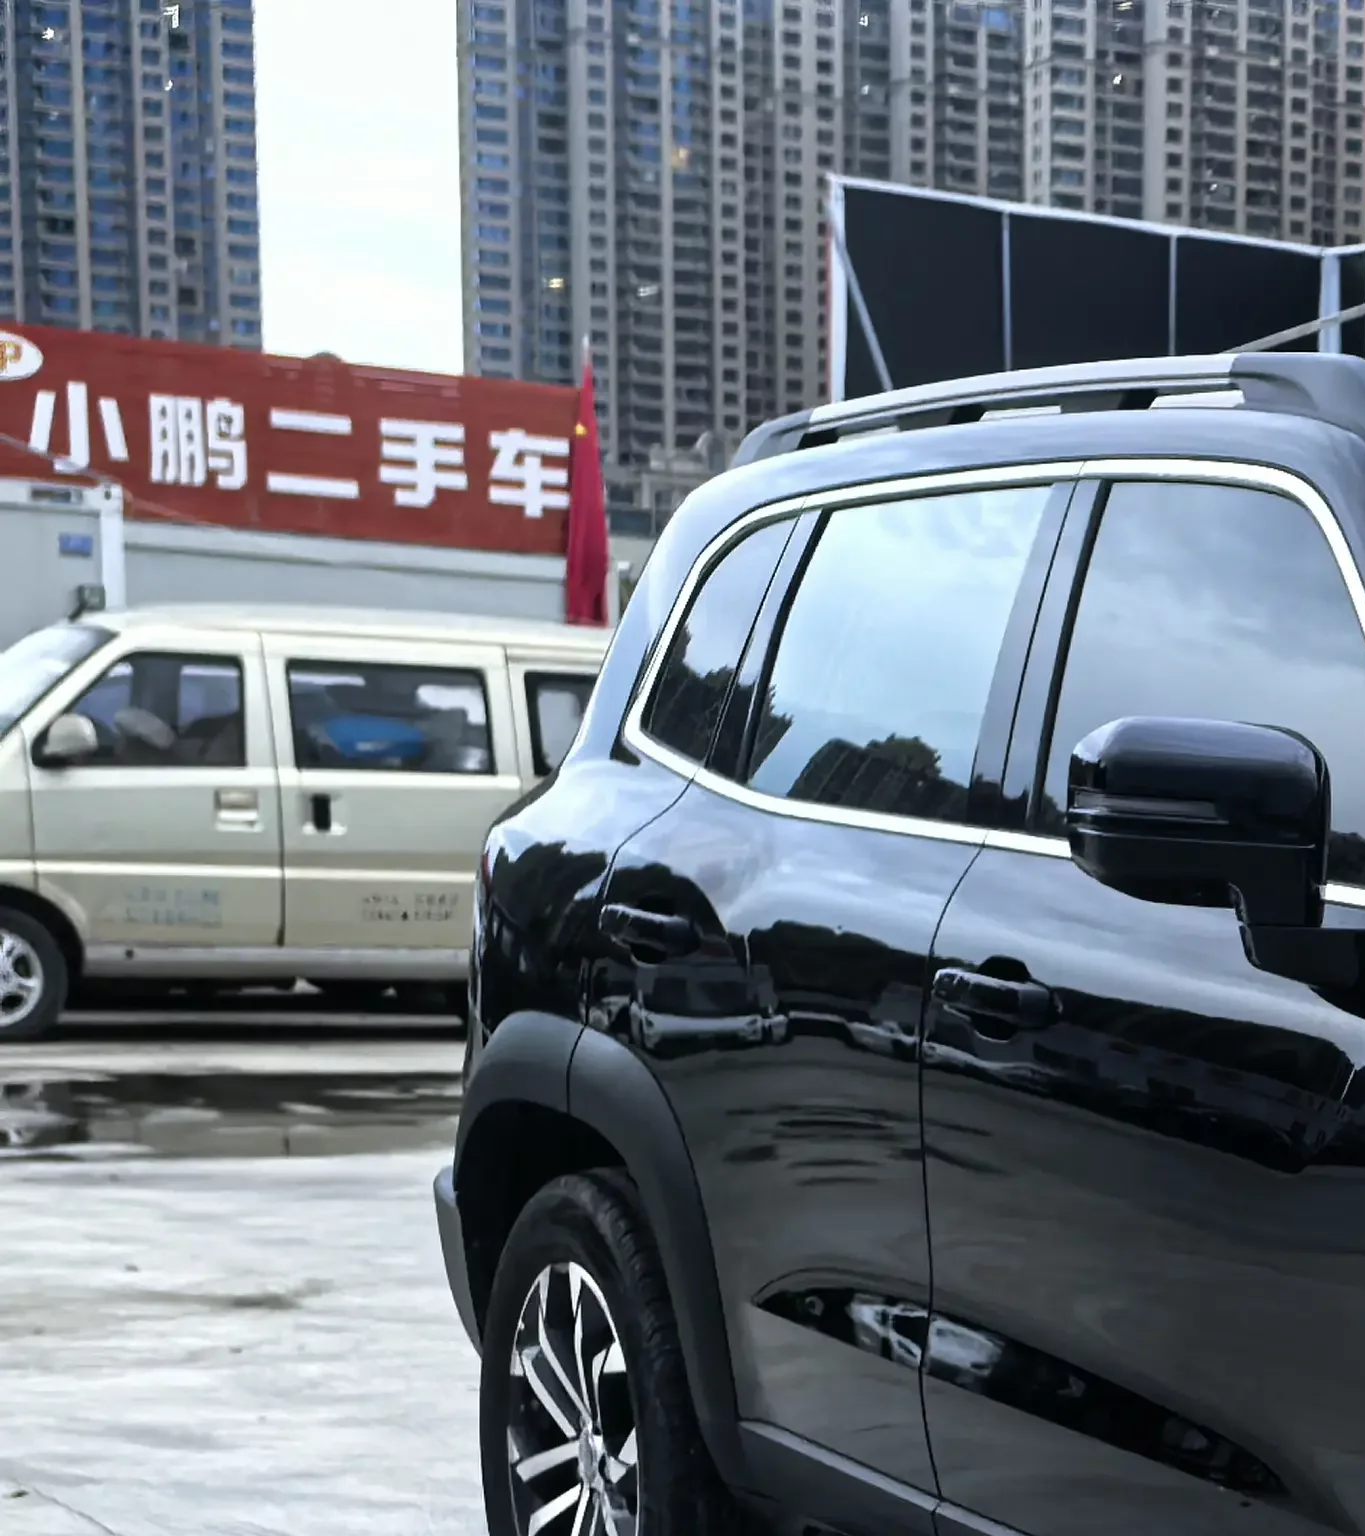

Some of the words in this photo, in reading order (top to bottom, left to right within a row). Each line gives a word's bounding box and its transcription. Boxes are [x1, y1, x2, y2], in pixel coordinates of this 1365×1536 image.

[29, 380, 570, 519] 小鹏二手车
